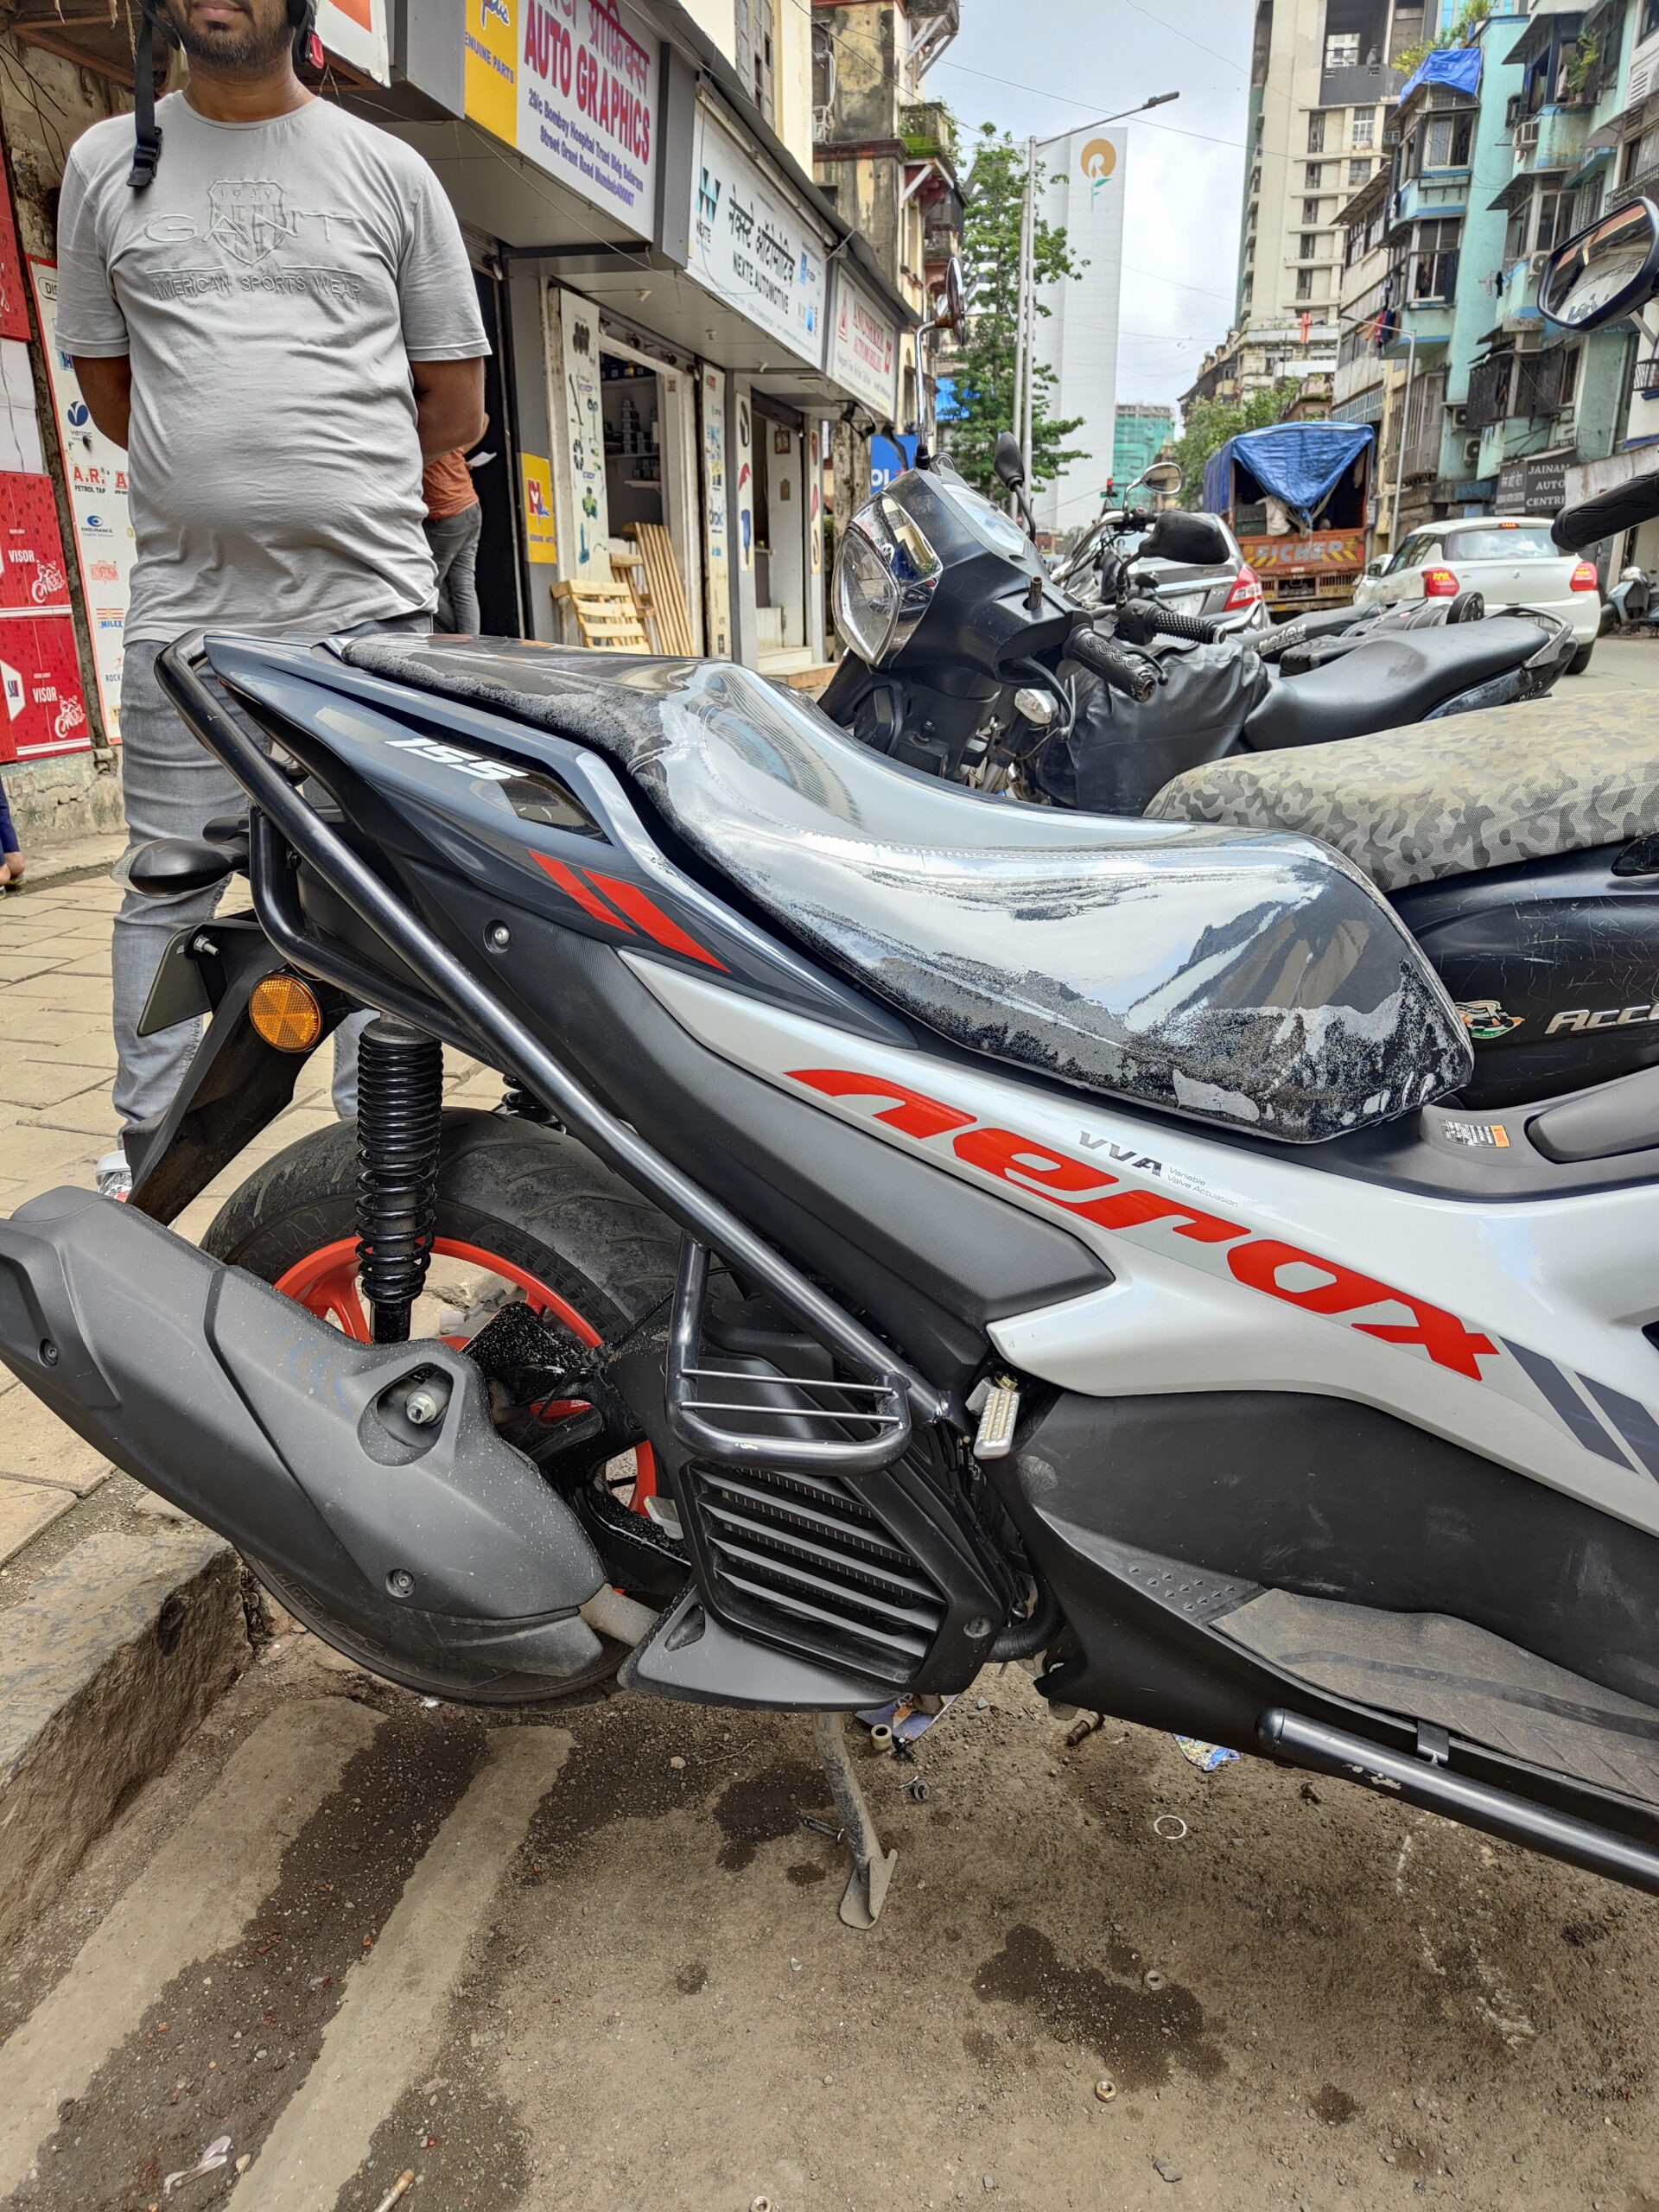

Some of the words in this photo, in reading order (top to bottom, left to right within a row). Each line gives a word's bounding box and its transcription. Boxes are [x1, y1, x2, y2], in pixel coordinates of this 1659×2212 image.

[493, 54, 514, 85] PARTS
[524, 0, 571, 98] AUTO
[576, 43, 650, 166] GRAPHICS
[543, 99, 569, 138] Bombay
[562, 140, 578, 168] Grant
[579, 154, 594, 180] Road
[144, 210, 359, 244] GANT
[733, 249, 753, 286] NEXTE
[152, 274, 232, 301] AMERICAN
[241, 275, 306, 294] SPORTS
[314, 276, 361, 300] WEAR
[1526, 495, 1566, 507] CENTR
[1535, 480, 1566, 491] AUTO
[8, 550, 35, 563] VISOR
[32, 687, 58, 703] VISOR
[384, 738, 531, 781] 155
[1079, 1130, 1162, 1178] VVA
[1167, 1175, 1192, 1189] Valve
[1192, 1185, 1239, 1207] Actuation
[1169, 1166, 1206, 1186] Variable
